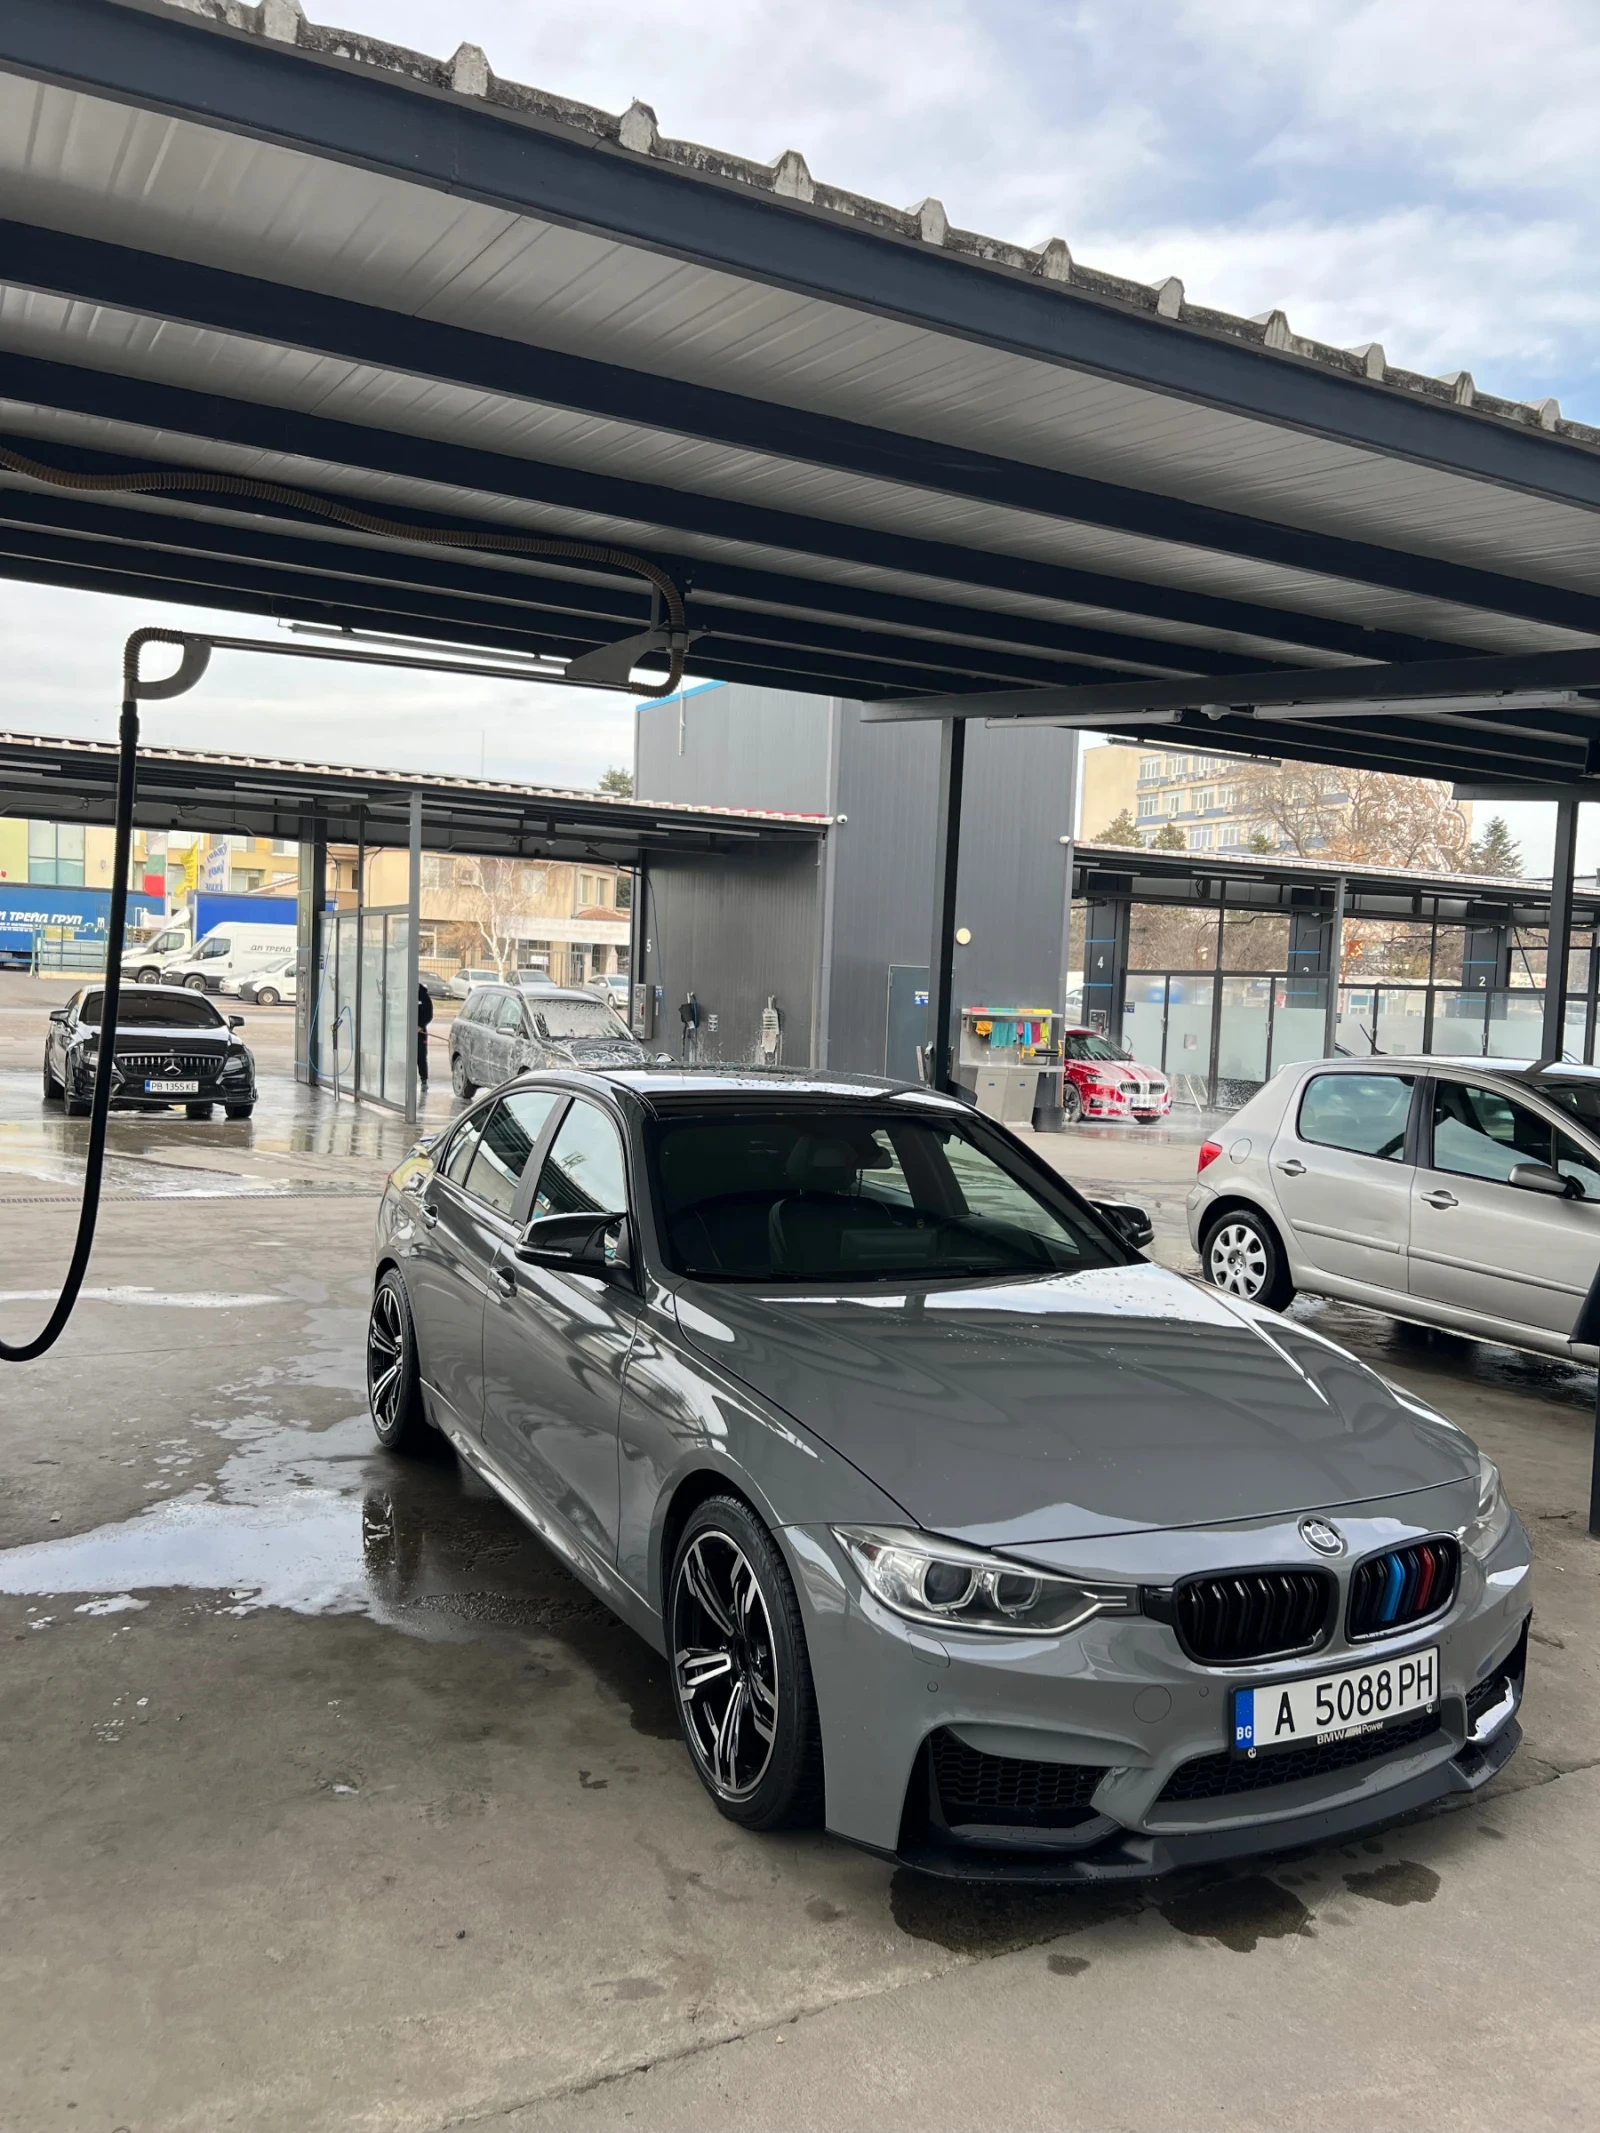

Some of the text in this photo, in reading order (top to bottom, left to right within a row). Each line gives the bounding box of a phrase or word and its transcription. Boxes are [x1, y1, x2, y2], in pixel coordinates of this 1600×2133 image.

[51, 914, 83, 925] ГРУП
[646, 939, 651, 953] 5
[1097, 956, 1104, 969] 4
[1479, 976, 1486, 987] 2
[165, 1082, 185, 1091] 1355
[1274, 1655, 1433, 1736] A 5088 PH
[1236, 1725, 1253, 1741] BG
[1361, 1721, 1384, 1734] Power
